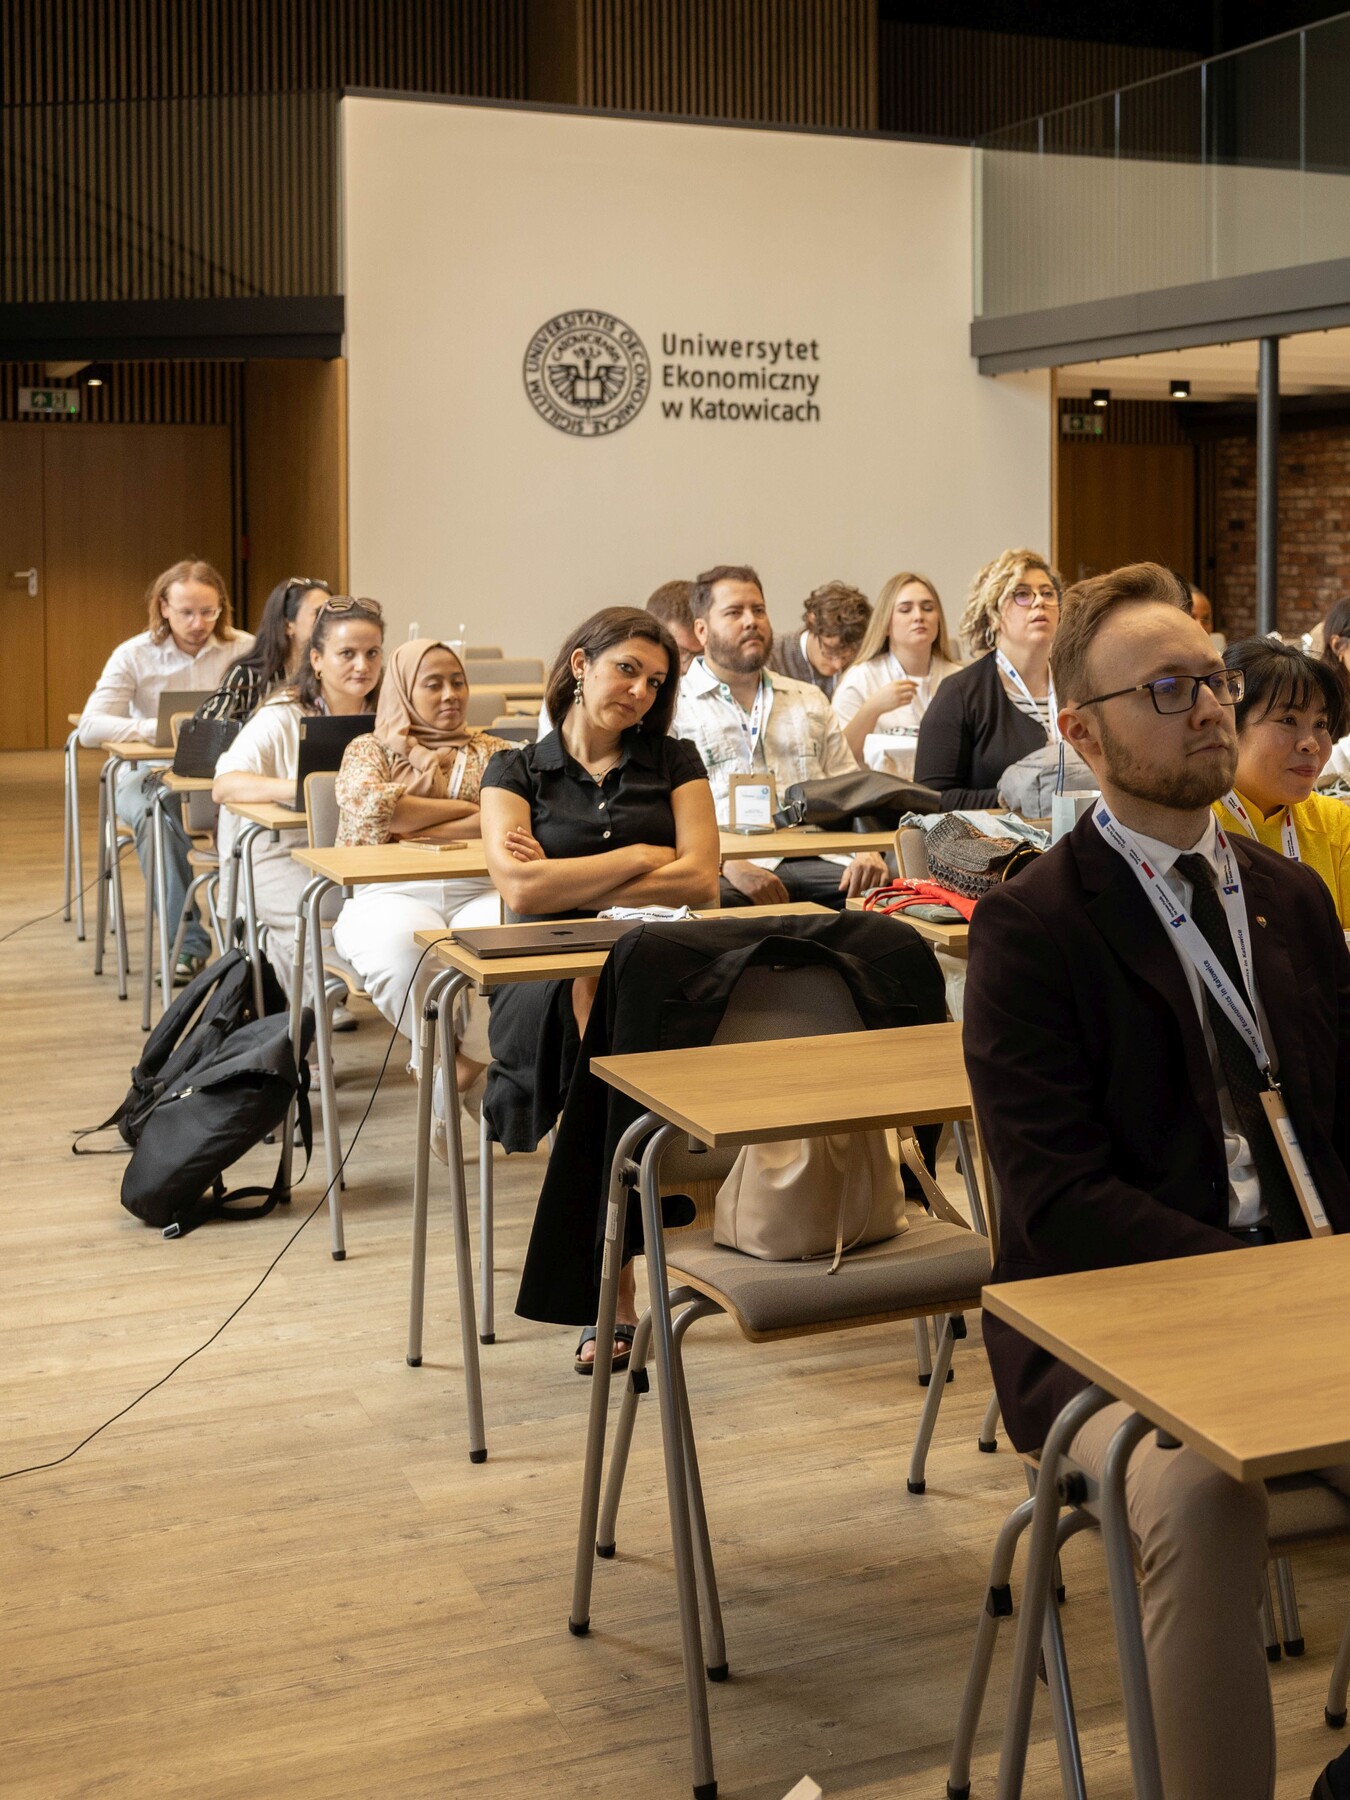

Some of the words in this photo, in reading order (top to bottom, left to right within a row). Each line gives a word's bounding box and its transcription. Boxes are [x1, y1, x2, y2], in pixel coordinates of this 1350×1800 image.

[527, 313, 616, 372] UNIVERSITATIS
[662, 333, 820, 364] Uniwersytet
[594, 332, 646, 434] OECONOMICAE
[662, 364, 820, 397] Ekonomiczny
[530, 380, 582, 434] SIGILLUM
[661, 401, 683, 419] w
[690, 397, 820, 421] Katowicach
[1238, 930, 1246, 958] Katowice
[1203, 960, 1222, 988] Katowice
[1220, 988, 1228, 996] in
[1225, 996, 1247, 1028] Economics
